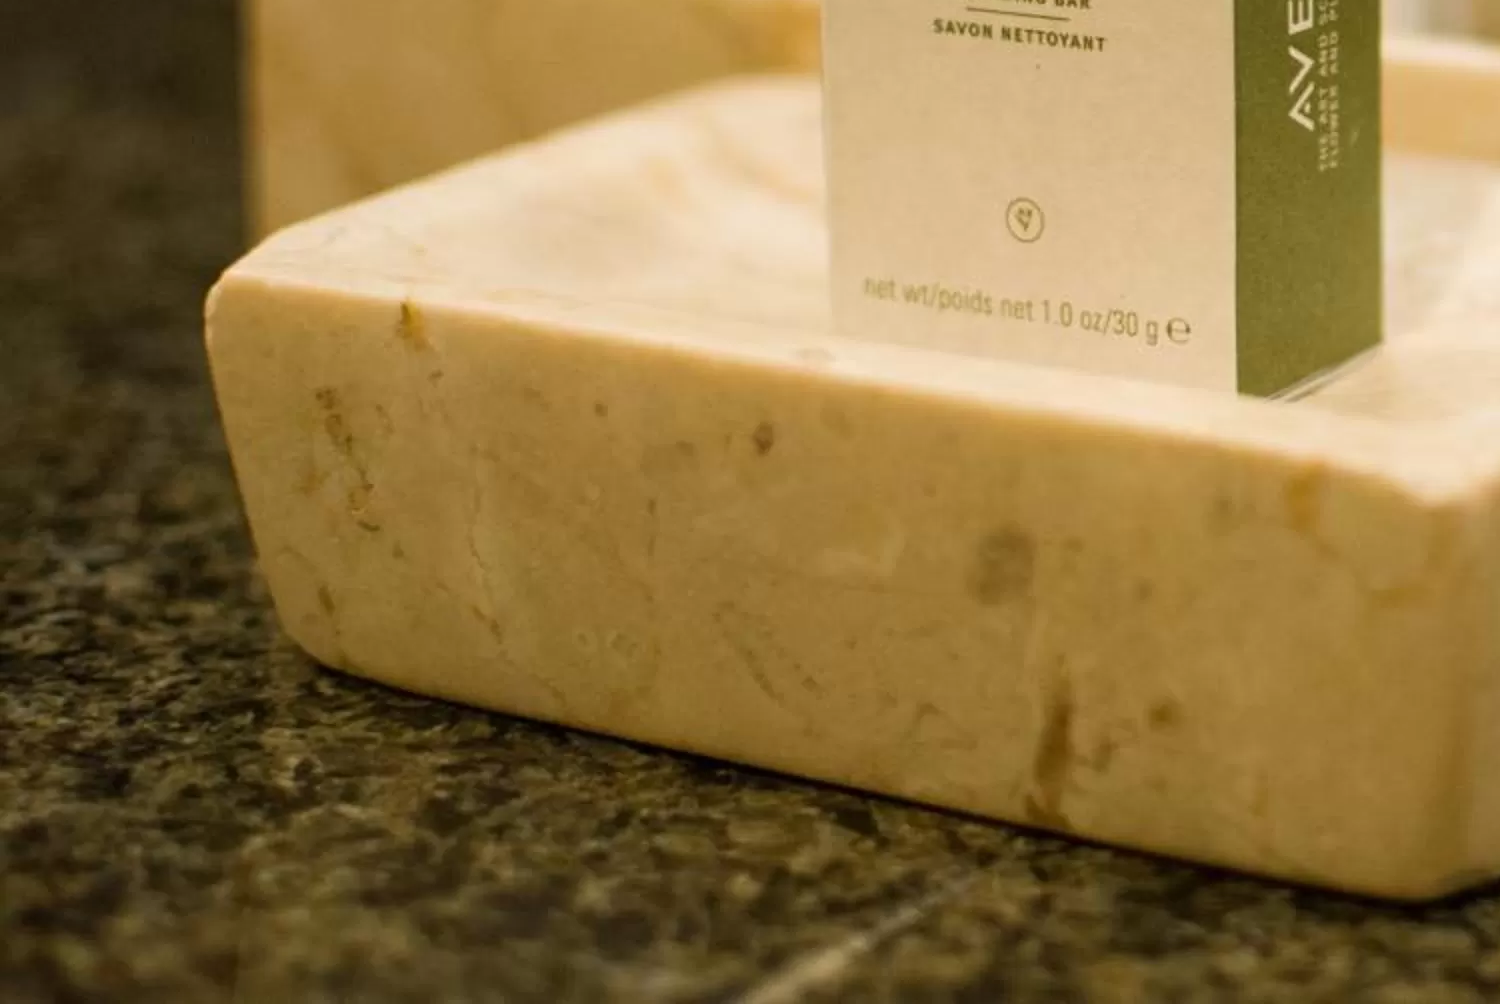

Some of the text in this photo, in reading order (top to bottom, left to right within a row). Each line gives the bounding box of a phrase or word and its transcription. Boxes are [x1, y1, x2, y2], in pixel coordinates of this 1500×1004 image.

[932, 18, 1109, 53] SAVON NETTOYANT
[1317, 34, 1329, 77] AND
[1328, 30, 1340, 75] AND
[863, 276, 896, 299] net
[903, 280, 993, 317] wt/poids
[1000, 297, 1033, 323] net
[1042, 299, 1073, 328] 1.0
[1080, 308, 1139, 338] oz/30
[1146, 319, 1159, 347] g
